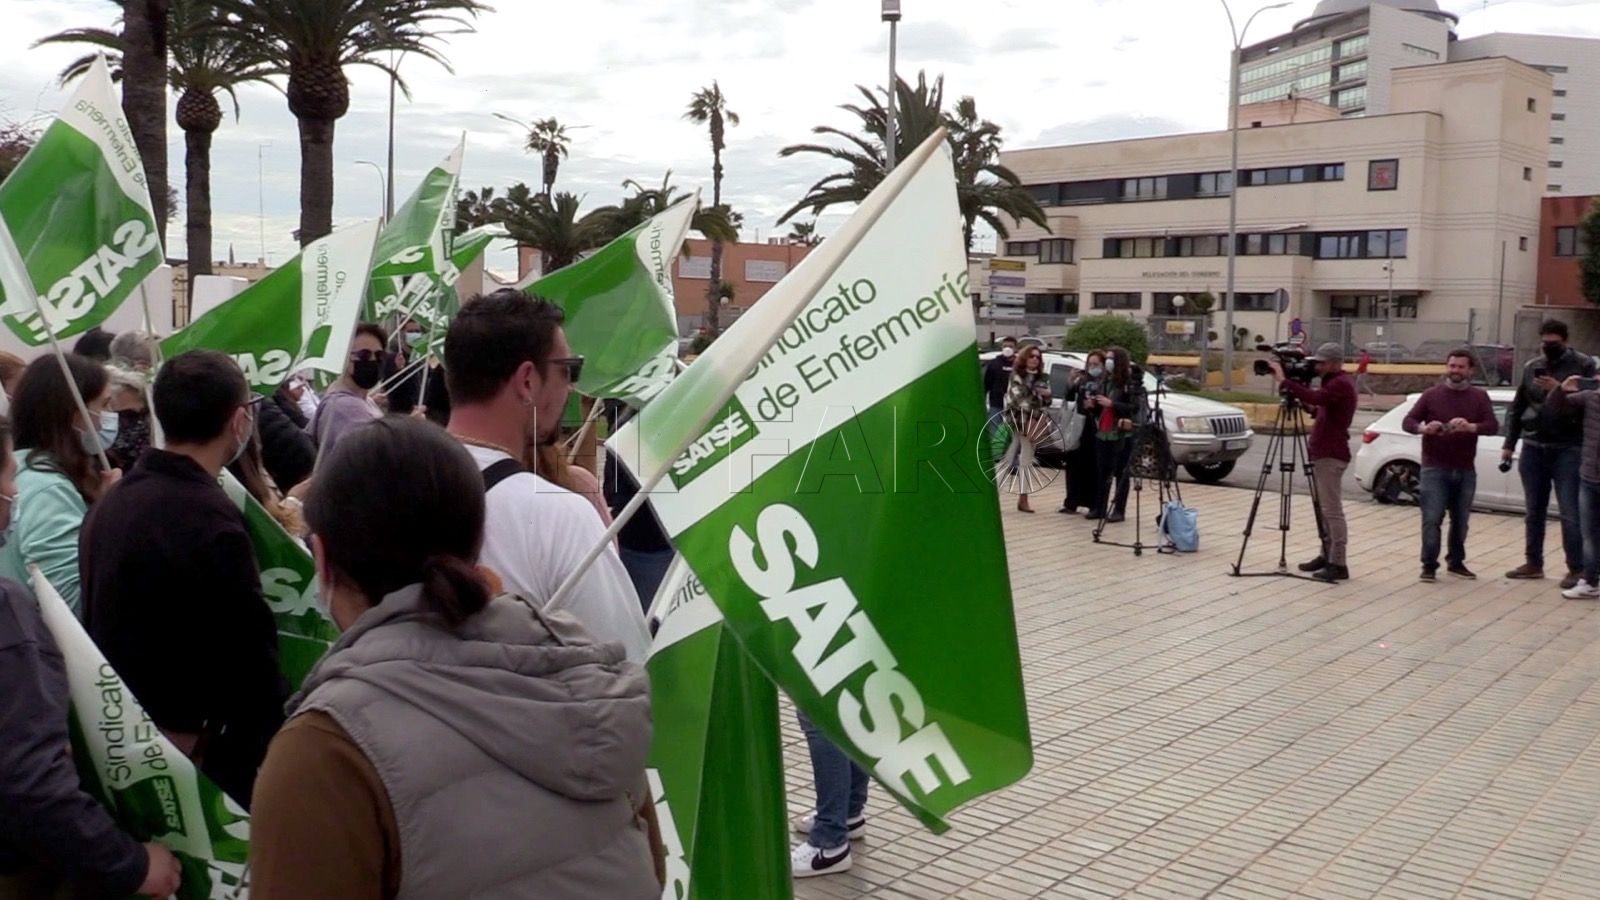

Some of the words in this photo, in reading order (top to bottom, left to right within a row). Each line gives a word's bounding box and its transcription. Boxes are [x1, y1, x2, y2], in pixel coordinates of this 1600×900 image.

[756, 385, 799, 421] de
[795, 270, 969, 394] Enfermería
[672, 411, 749, 475] SATSE
[729, 503, 971, 806] SATSE
[95, 663, 131, 782] Sindicato
[141, 744, 168, 770] de
